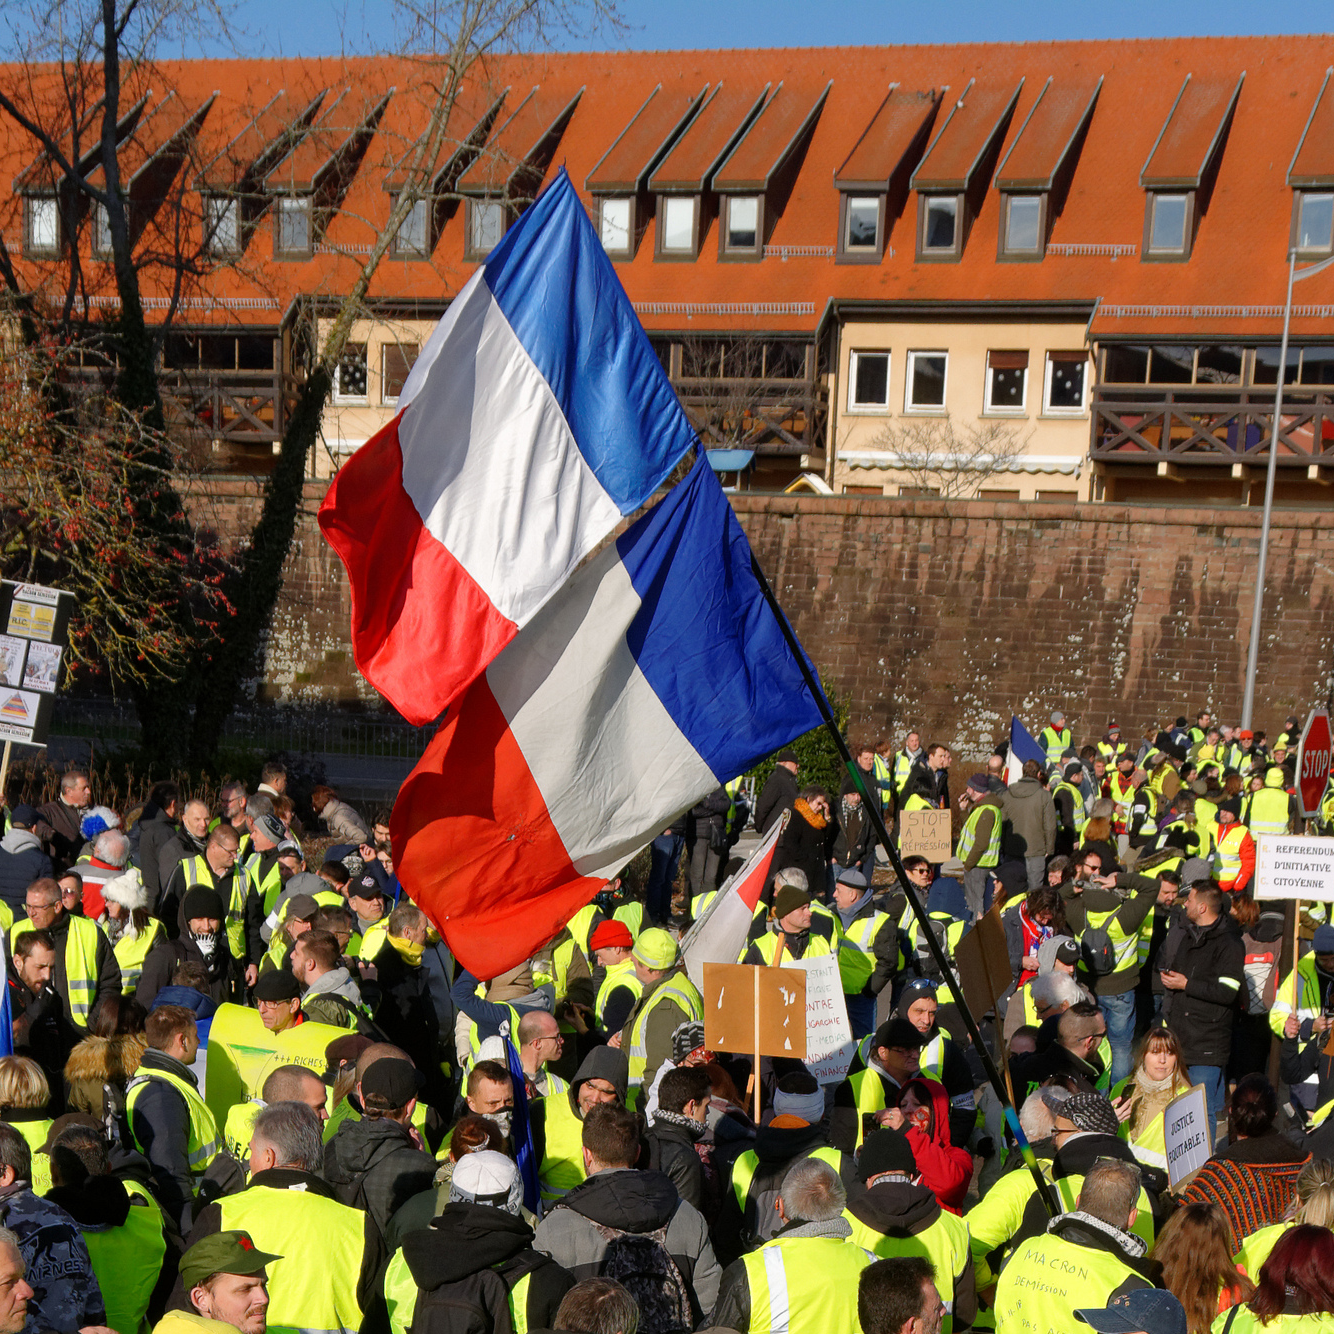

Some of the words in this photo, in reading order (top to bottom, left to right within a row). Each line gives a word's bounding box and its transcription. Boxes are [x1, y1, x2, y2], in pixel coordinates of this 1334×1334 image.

[1302, 749, 1330, 779] STOP
[908, 811, 950, 826] STOP
[905, 828, 913, 838] A
[921, 828, 936, 838] LA
[1274, 861, 1332, 873] D'INITIATIVE
[1273, 877, 1325, 889] CITOYENNE
[805, 998, 834, 1012] ONTRE
[803, 1051, 834, 1065] ENDUS
[814, 1065, 850, 1078] FINANCE
[1170, 1111, 1195, 1136] JUSTICE
[1168, 1132, 1202, 1164] EQUITABLE
[1024, 1249, 1088, 1280] MACRON
[1022, 1318, 1037, 1331] PAS
